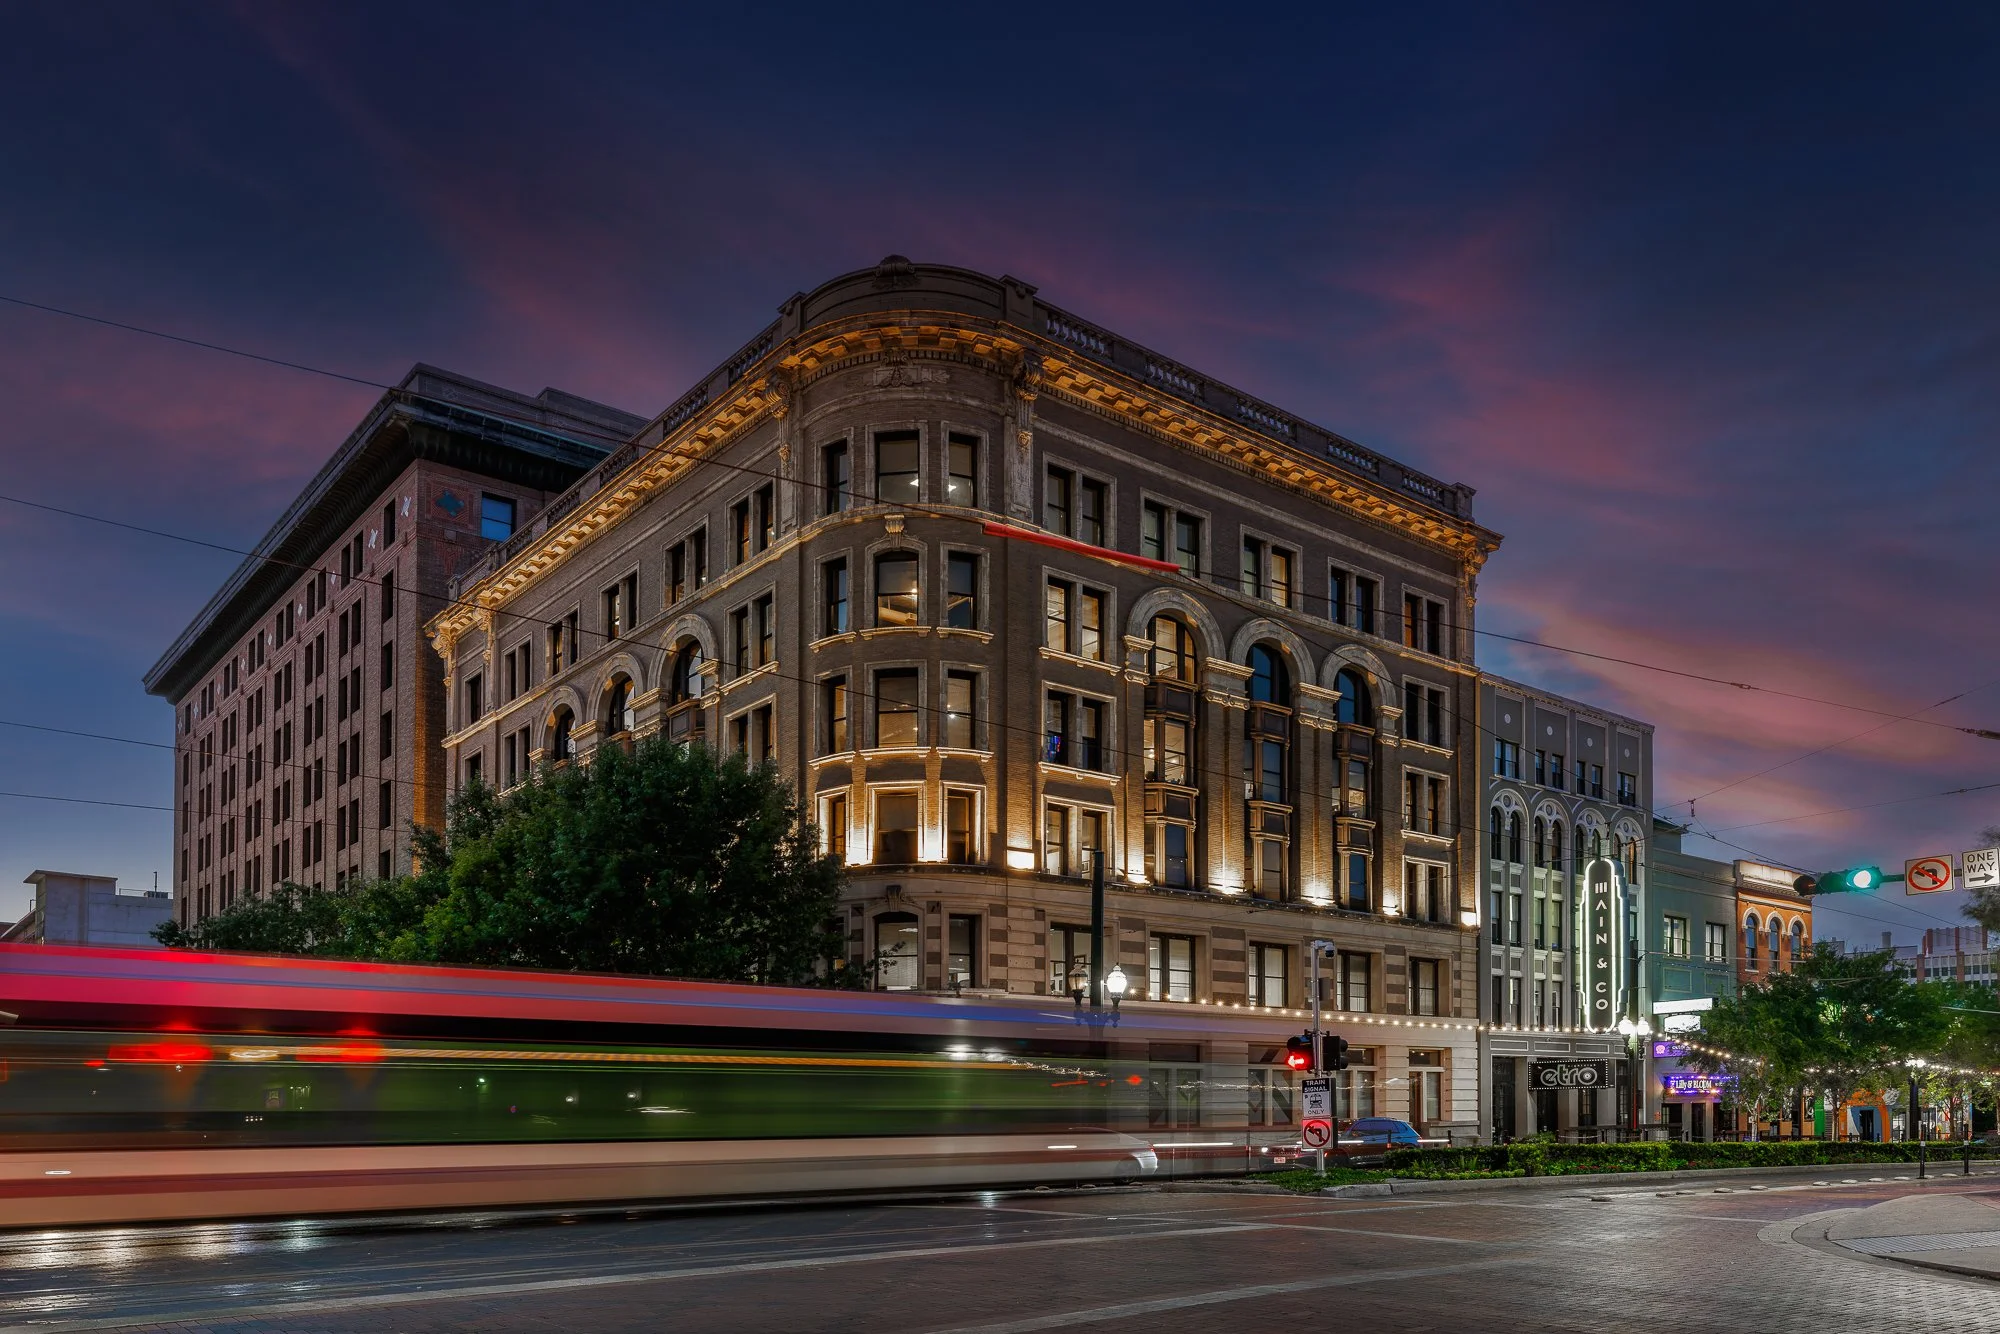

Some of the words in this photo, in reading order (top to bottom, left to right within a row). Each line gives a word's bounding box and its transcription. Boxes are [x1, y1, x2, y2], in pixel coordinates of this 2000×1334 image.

[1967, 851, 1995, 863] ONE
[1967, 861, 1995, 873] WAY
[1596, 957, 1608, 969] &
[1595, 981, 1609, 1010] CO
[1540, 1064, 1598, 1086] etro
